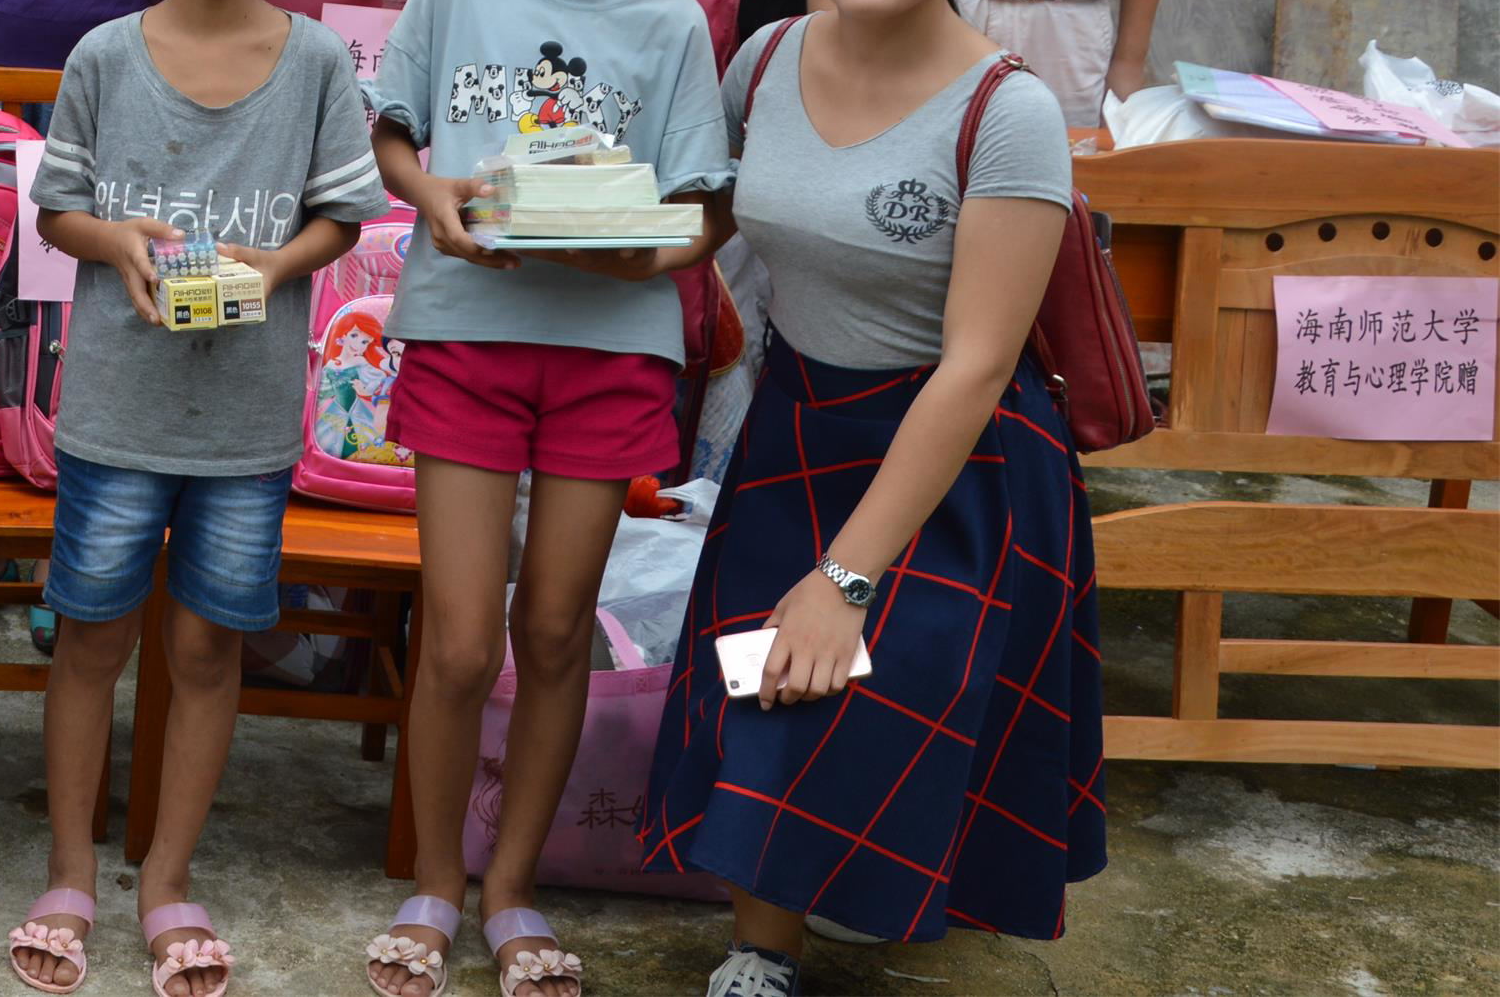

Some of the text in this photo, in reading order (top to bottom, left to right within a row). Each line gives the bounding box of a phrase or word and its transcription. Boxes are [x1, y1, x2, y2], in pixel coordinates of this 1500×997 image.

[95, 180, 298, 248] 안녕하세요
[883, 201, 931, 223] DR
[1296, 307, 1481, 345] 海南师范大学
[1294, 358, 1480, 398] 教育与心理学院赠
